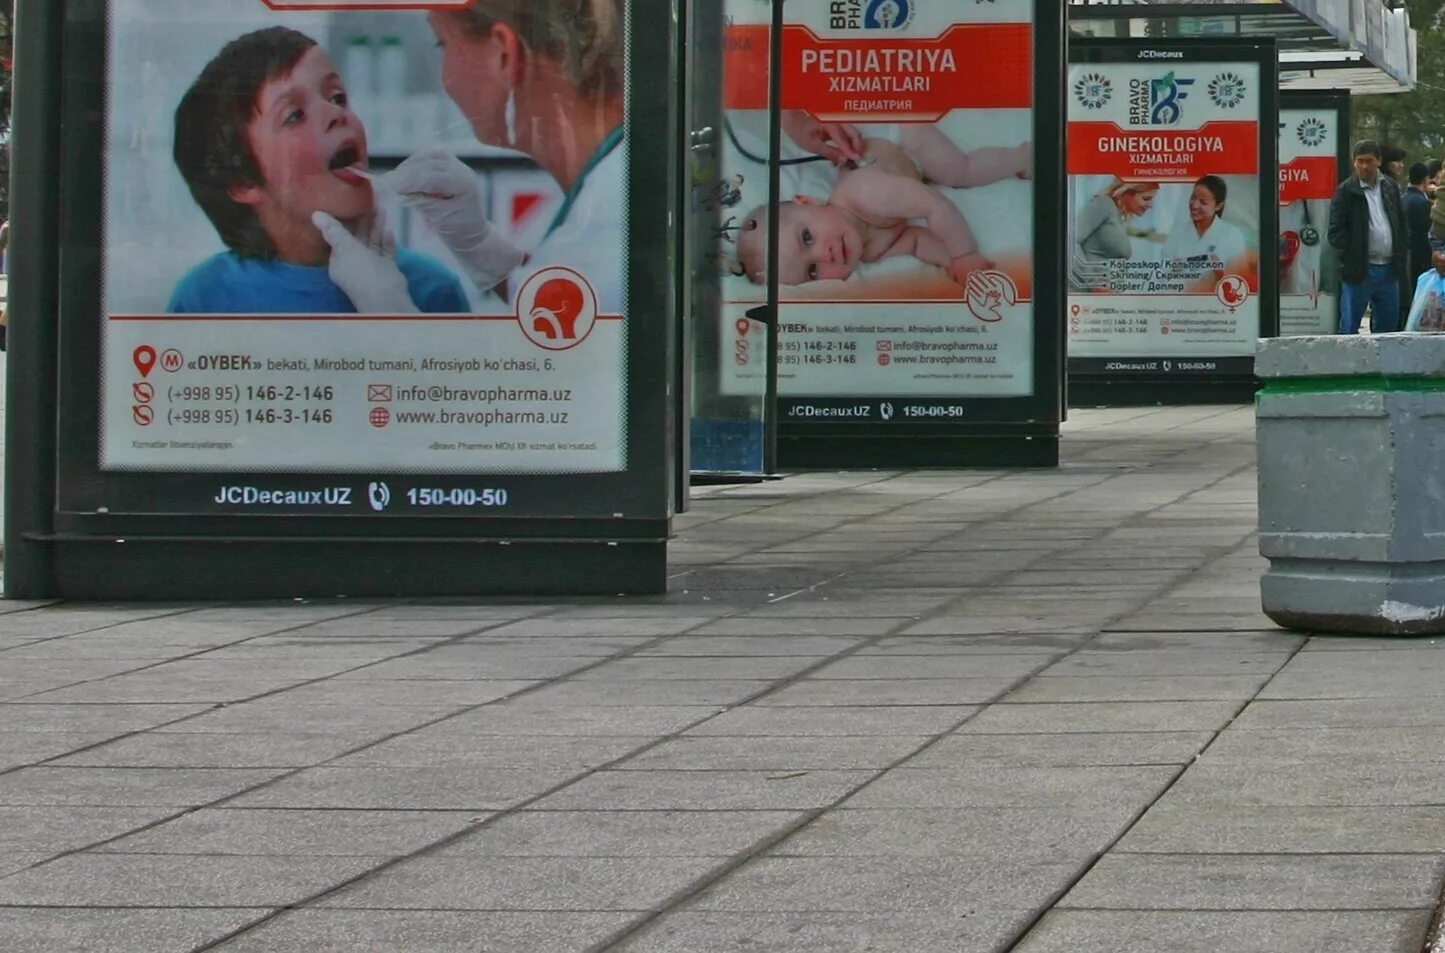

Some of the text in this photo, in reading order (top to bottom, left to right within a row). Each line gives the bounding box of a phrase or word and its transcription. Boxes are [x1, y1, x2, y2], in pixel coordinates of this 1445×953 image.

[801, 48, 958, 73] PEDIATRIYA
[828, 76, 931, 93] XIZMATLARI
[843, 99, 913, 112] ПЕДИАТРИЯ
[1129, 77, 1141, 126] BRAVO
[1141, 79, 1150, 126] PHARMA
[1098, 136, 1224, 153] GINEKOLOGIYA
[1129, 152, 1194, 164] XIZMATLARI
[804, 340, 857, 352] 146-2-146
[893, 340, 999, 353] info@bravopharma.uz
[187, 354, 262, 371] «OYBEK»
[266, 357, 310, 372] bekati,
[314, 357, 365, 371] Mirobod
[368, 358, 417, 372] tumani,
[421, 357, 480, 374] Afrosiyob
[543, 358, 556, 372] 6.
[804, 354, 857, 366] 146-3-146
[893, 354, 997, 367] www.bravopharma.uz
[167, 384, 334, 402] (+998 95) 146-2-146
[396, 385, 572, 405] info@bravopharma.uz
[167, 408, 333, 426] (+998 95) 146-3-146
[396, 408, 569, 428] www.bravopharma.uz
[788, 405, 964, 418] JCDecauxUZ 150-00-50
[214, 485, 508, 506] JCDecauxUZ 150-00-50
